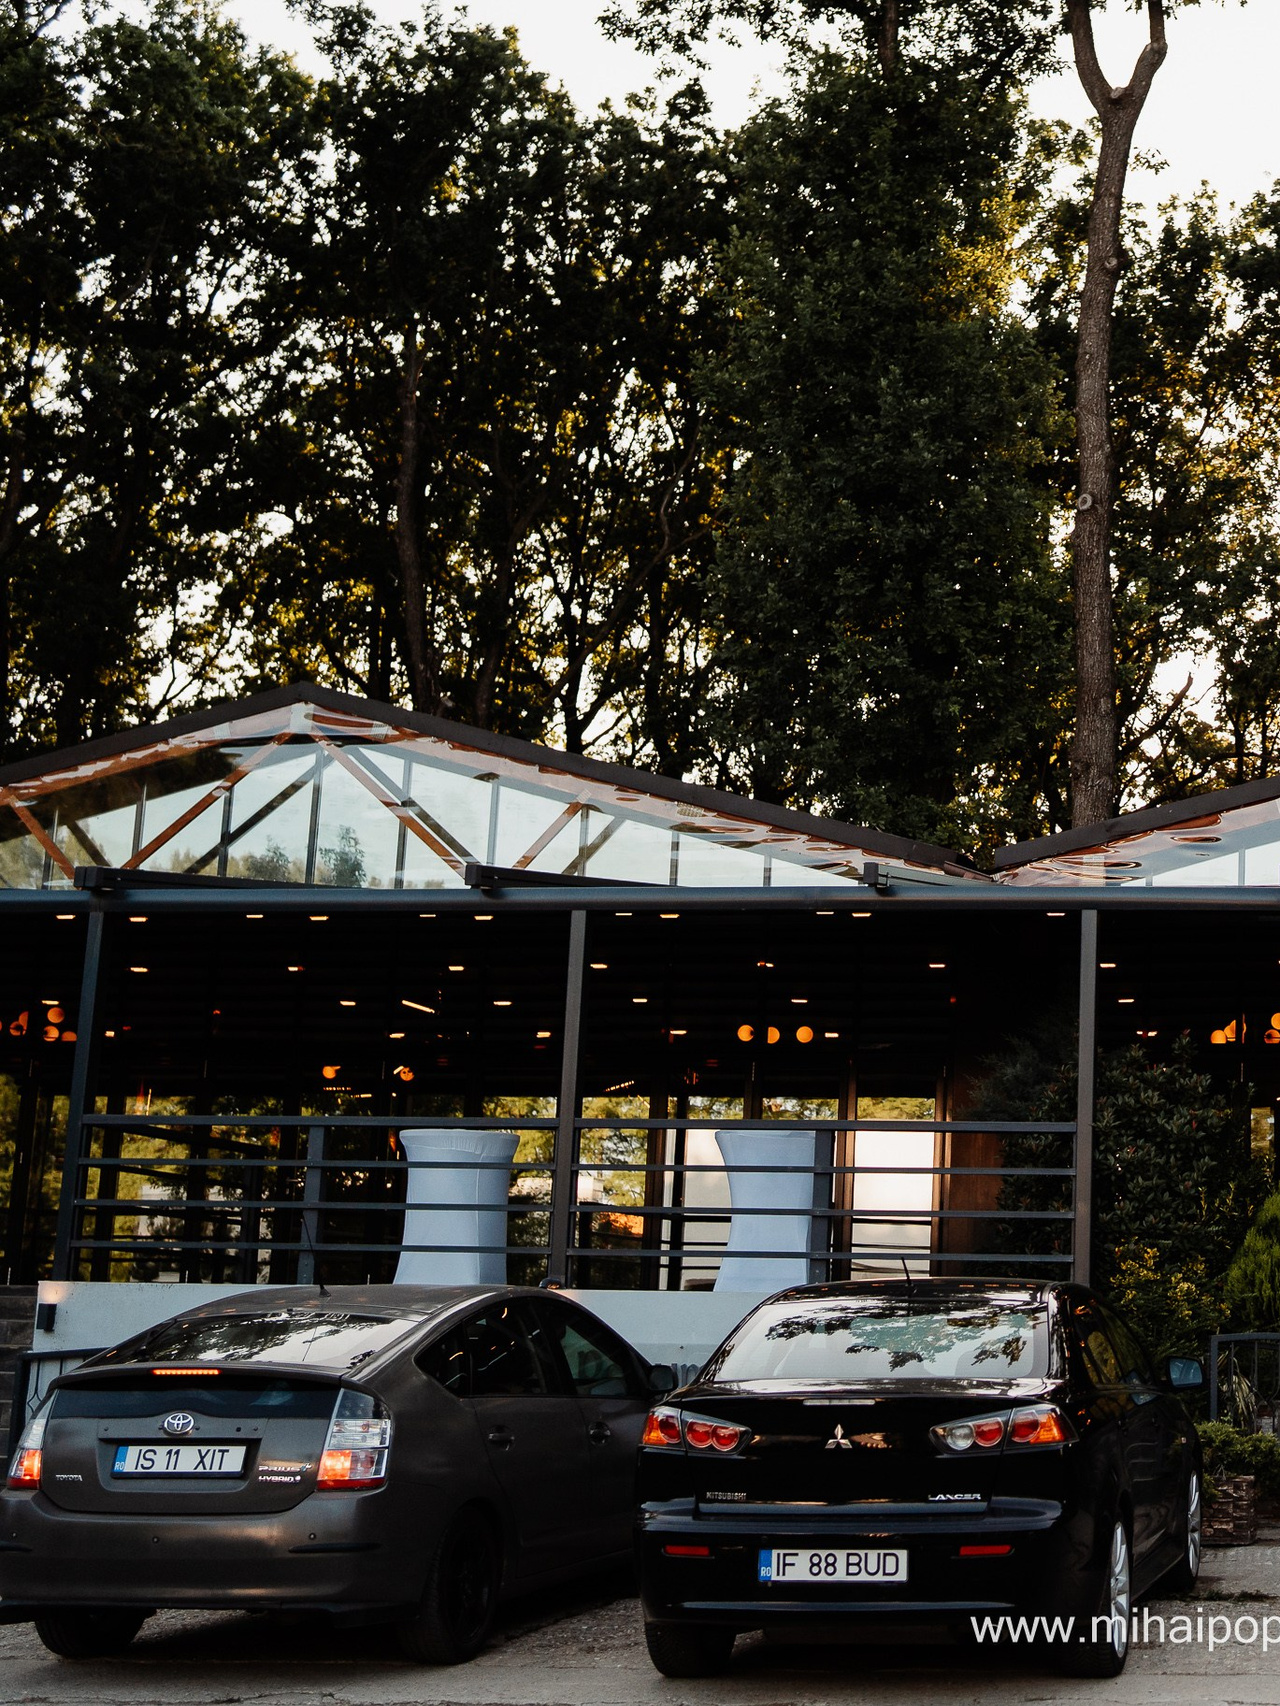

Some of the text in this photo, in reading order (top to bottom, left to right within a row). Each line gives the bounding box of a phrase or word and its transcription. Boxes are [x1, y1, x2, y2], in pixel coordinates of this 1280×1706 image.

[134, 1448, 230, 1471] IS 11 XIT
[114, 1461, 125, 1471] RO
[706, 1491, 747, 1501] MITSUBISHI
[776, 1552, 900, 1577] IF 88 BUD
[760, 1566, 772, 1577] RO
